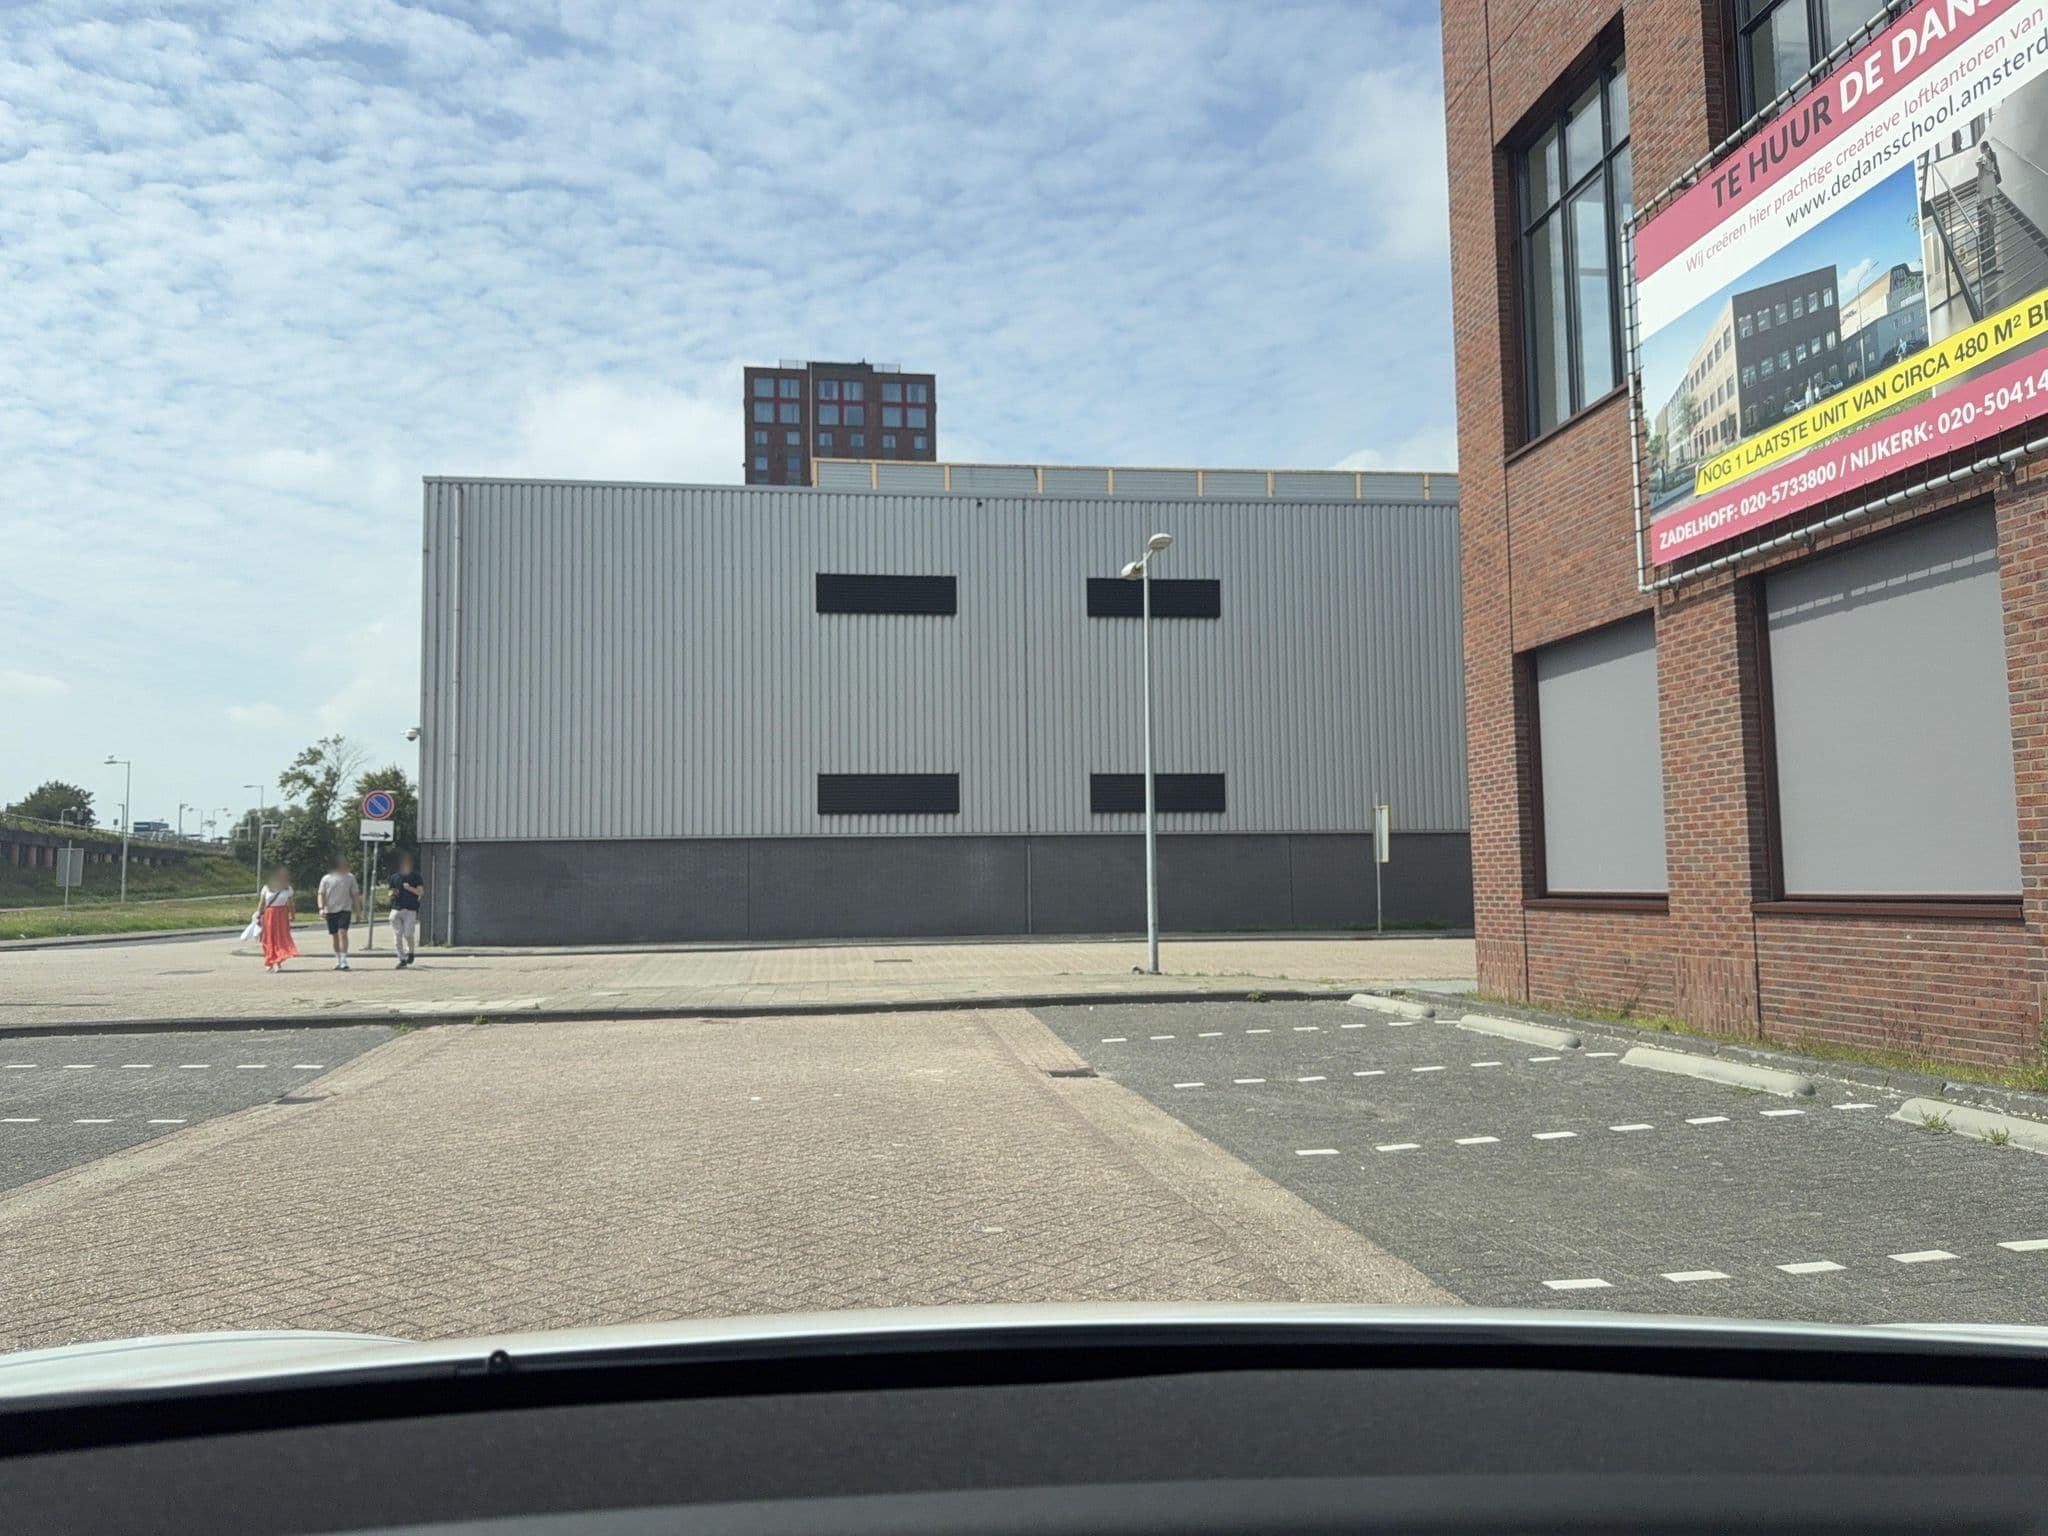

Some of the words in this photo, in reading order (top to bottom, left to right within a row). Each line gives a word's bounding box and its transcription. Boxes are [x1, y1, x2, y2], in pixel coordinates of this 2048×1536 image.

[1686, 250, 1704, 273] Wij
[1706, 221, 1746, 260] creëren
[1749, 204, 1771, 230] hier
[1774, 161, 1832, 215] prachtige
[1836, 112, 1900, 168] creatieve
[1903, 35, 2005, 118] loftkantoren
[2010, 8, 2043, 40] van
[1712, 163, 1742, 208] TE
[1748, 96, 1832, 184] HUUR
[1839, 50, 1884, 114] DE
[1891, 0, 1993, 74] DAN
[1785, 26, 2048, 228] www.dedansschool.amsterd
[1659, 504, 1738, 550] ZADELHOFF:
[1740, 461, 1837, 516] 020-5733800
[1840, 455, 1846, 478] /
[1850, 421, 1934, 472] NIJKERK:
[1937, 369, 2048, 434] 020-50414
[1703, 460, 1732, 485] NOG
[1735, 455, 1741, 470] 1
[1745, 421, 1809, 465] LAATSTE
[1812, 400, 1848, 433] UNIT
[1852, 382, 1887, 412] VAN
[1891, 352, 1950, 394] CIRCA
[1954, 331, 1988, 362] 480
[1993, 313, 2022, 345] M²
